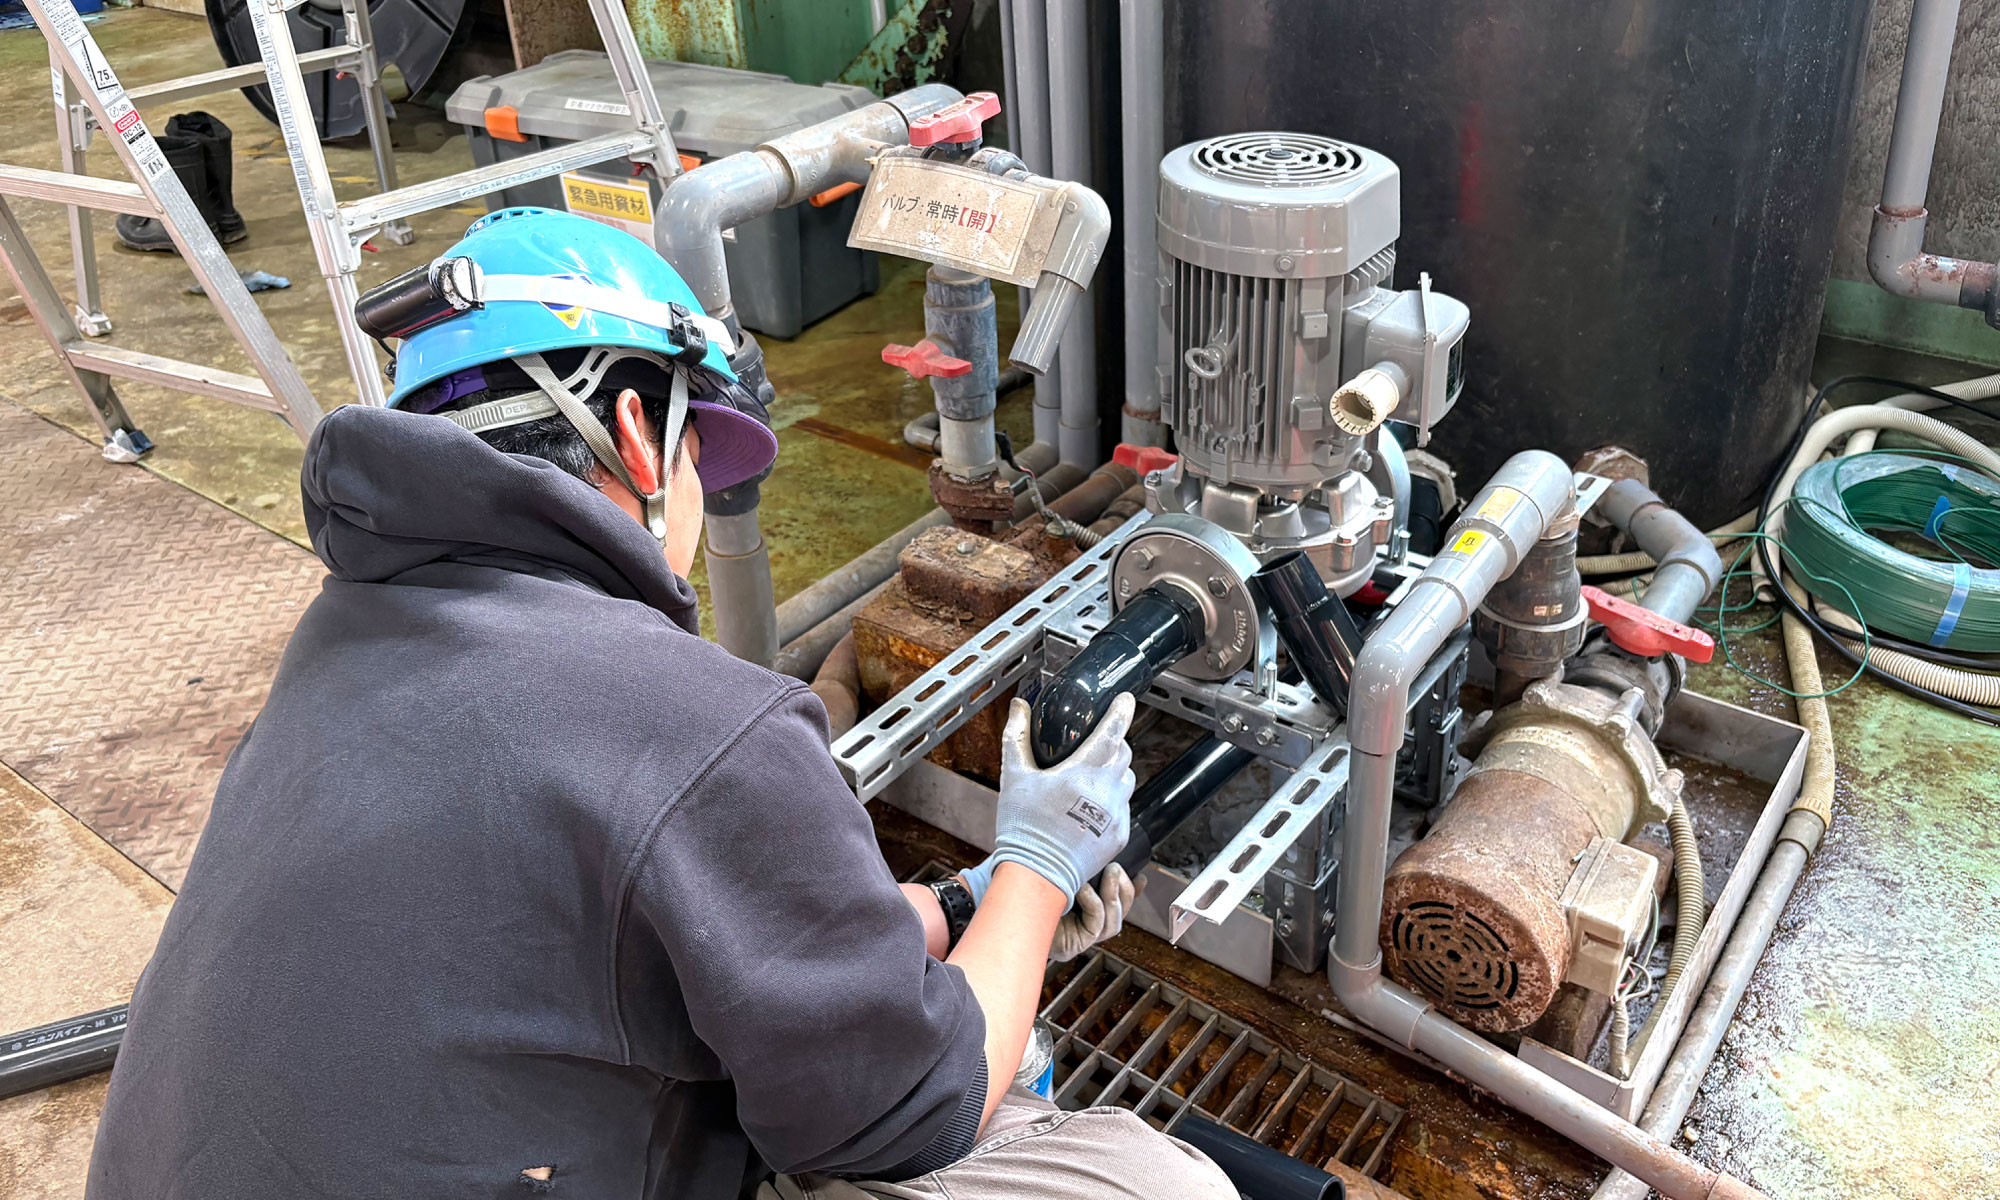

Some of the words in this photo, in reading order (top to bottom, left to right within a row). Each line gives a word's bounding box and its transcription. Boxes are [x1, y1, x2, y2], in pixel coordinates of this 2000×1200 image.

[568, 185, 645, 216] 緊急用資材
